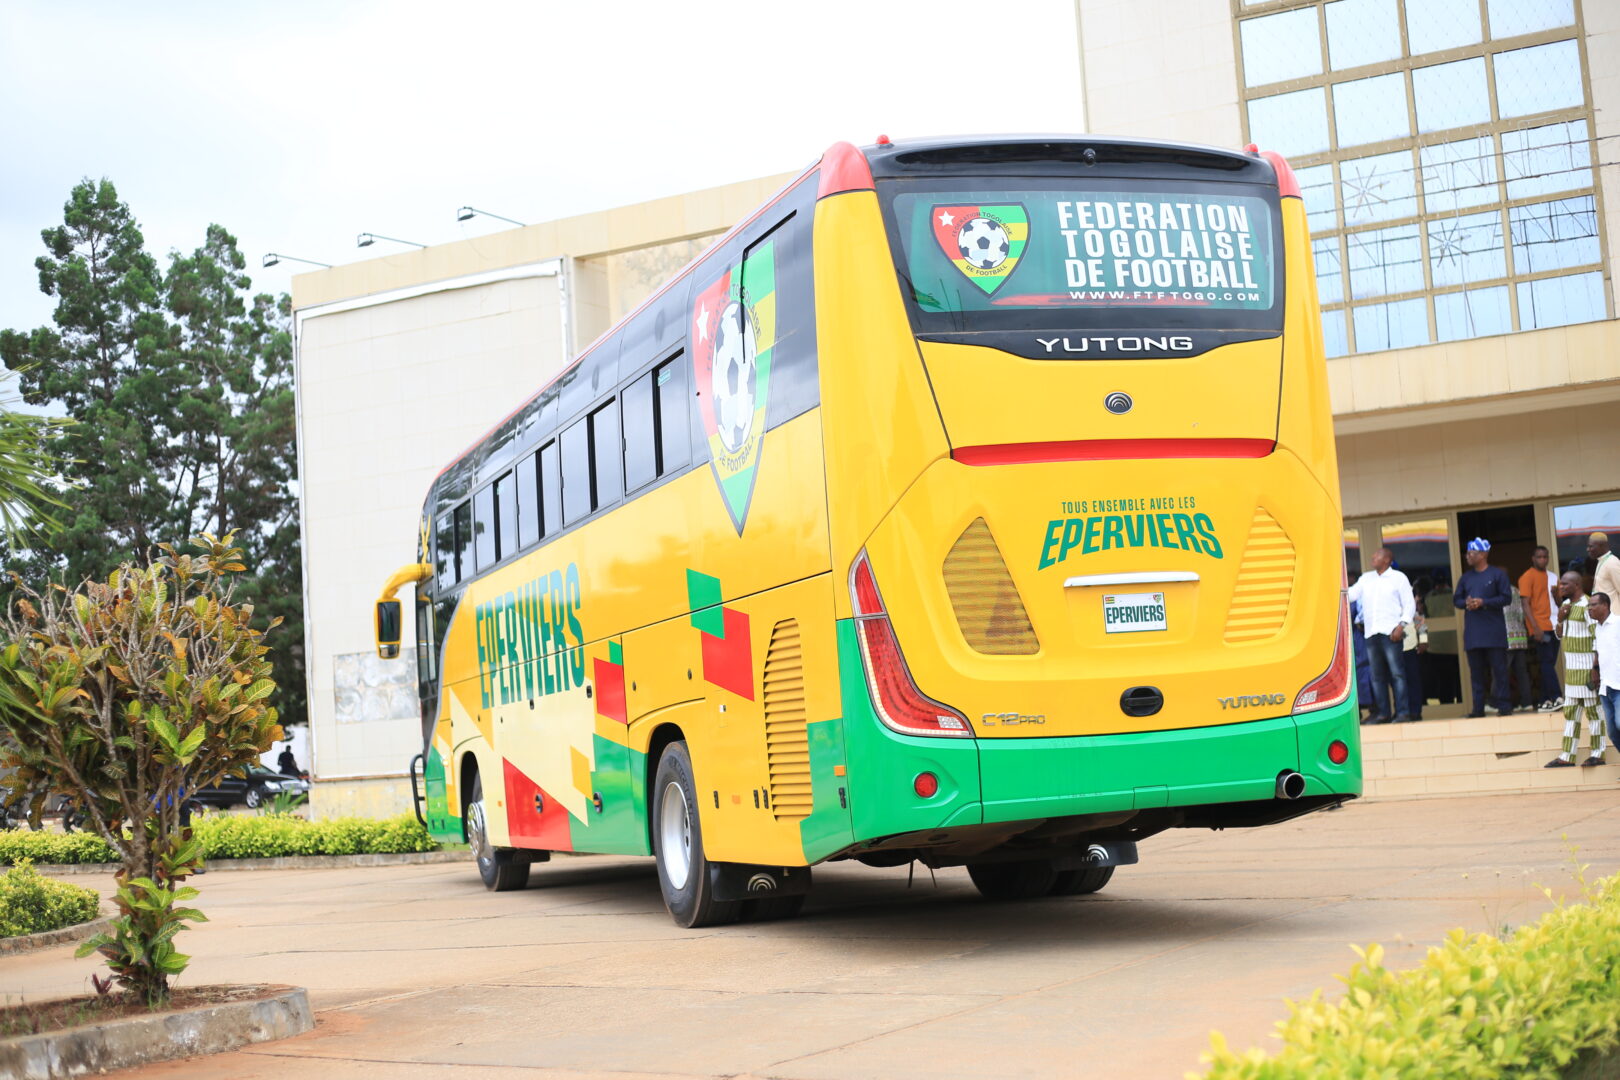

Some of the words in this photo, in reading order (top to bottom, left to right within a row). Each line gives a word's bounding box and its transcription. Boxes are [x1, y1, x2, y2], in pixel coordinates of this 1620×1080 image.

[1056, 201, 1250, 233] FEDERATION
[1061, 229, 1254, 260] TOGOLAISE
[965, 265, 975, 273] DE
[975, 264, 1008, 276] FOOTBALL
[1064, 259, 1106, 288] DE
[1113, 259, 1258, 289] FOOTBALL
[1069, 291, 1260, 302] WWW.FTFTOGO.COM
[1036, 336, 1193, 352] YUTONG
[1061, 500, 1088, 514] TOUS
[1092, 498, 1145, 513] ENSEMBLE
[1150, 497, 1175, 510] AVEC
[1178, 496, 1196, 509] LES
[1037, 512, 1224, 571] EPERVIERS
[1106, 604, 1164, 624] EPERVIERS
[475, 562, 585, 710] EPERVIERS
[1217, 693, 1286, 710] YUTONG
